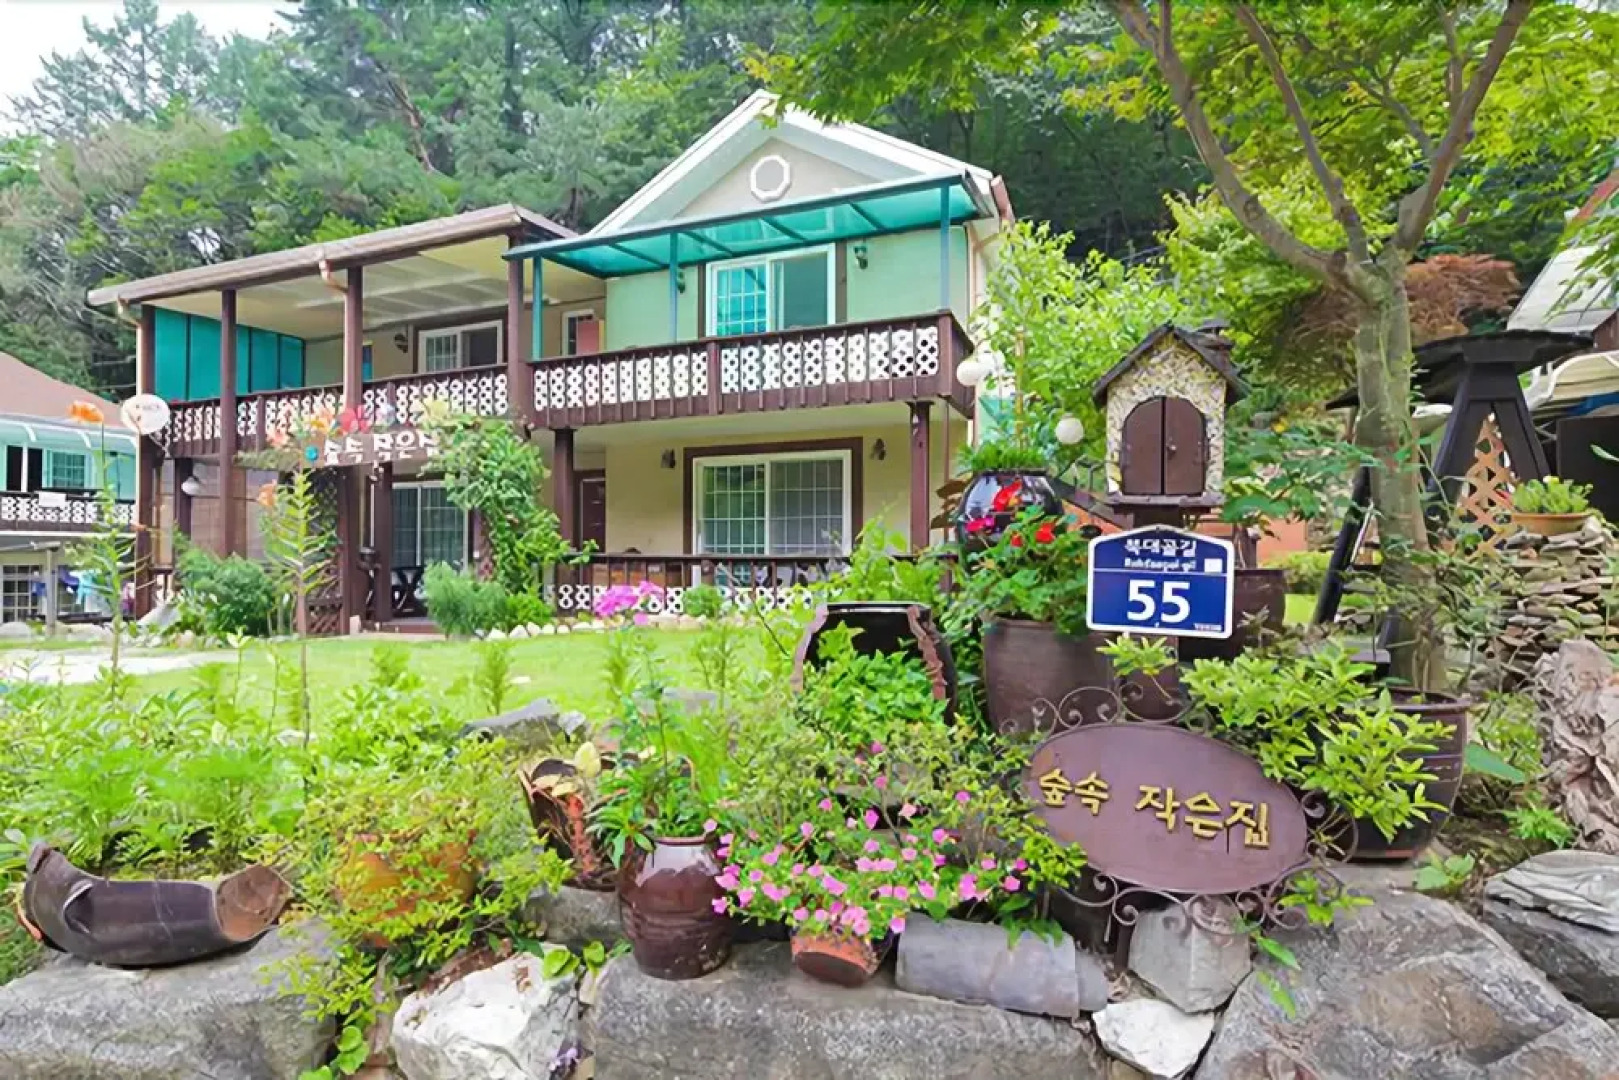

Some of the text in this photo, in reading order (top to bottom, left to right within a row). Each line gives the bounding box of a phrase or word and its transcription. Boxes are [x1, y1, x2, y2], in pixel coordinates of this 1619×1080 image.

[1126, 579, 1191, 623] 55
[1038, 768, 1271, 850] 숲속 작은집
